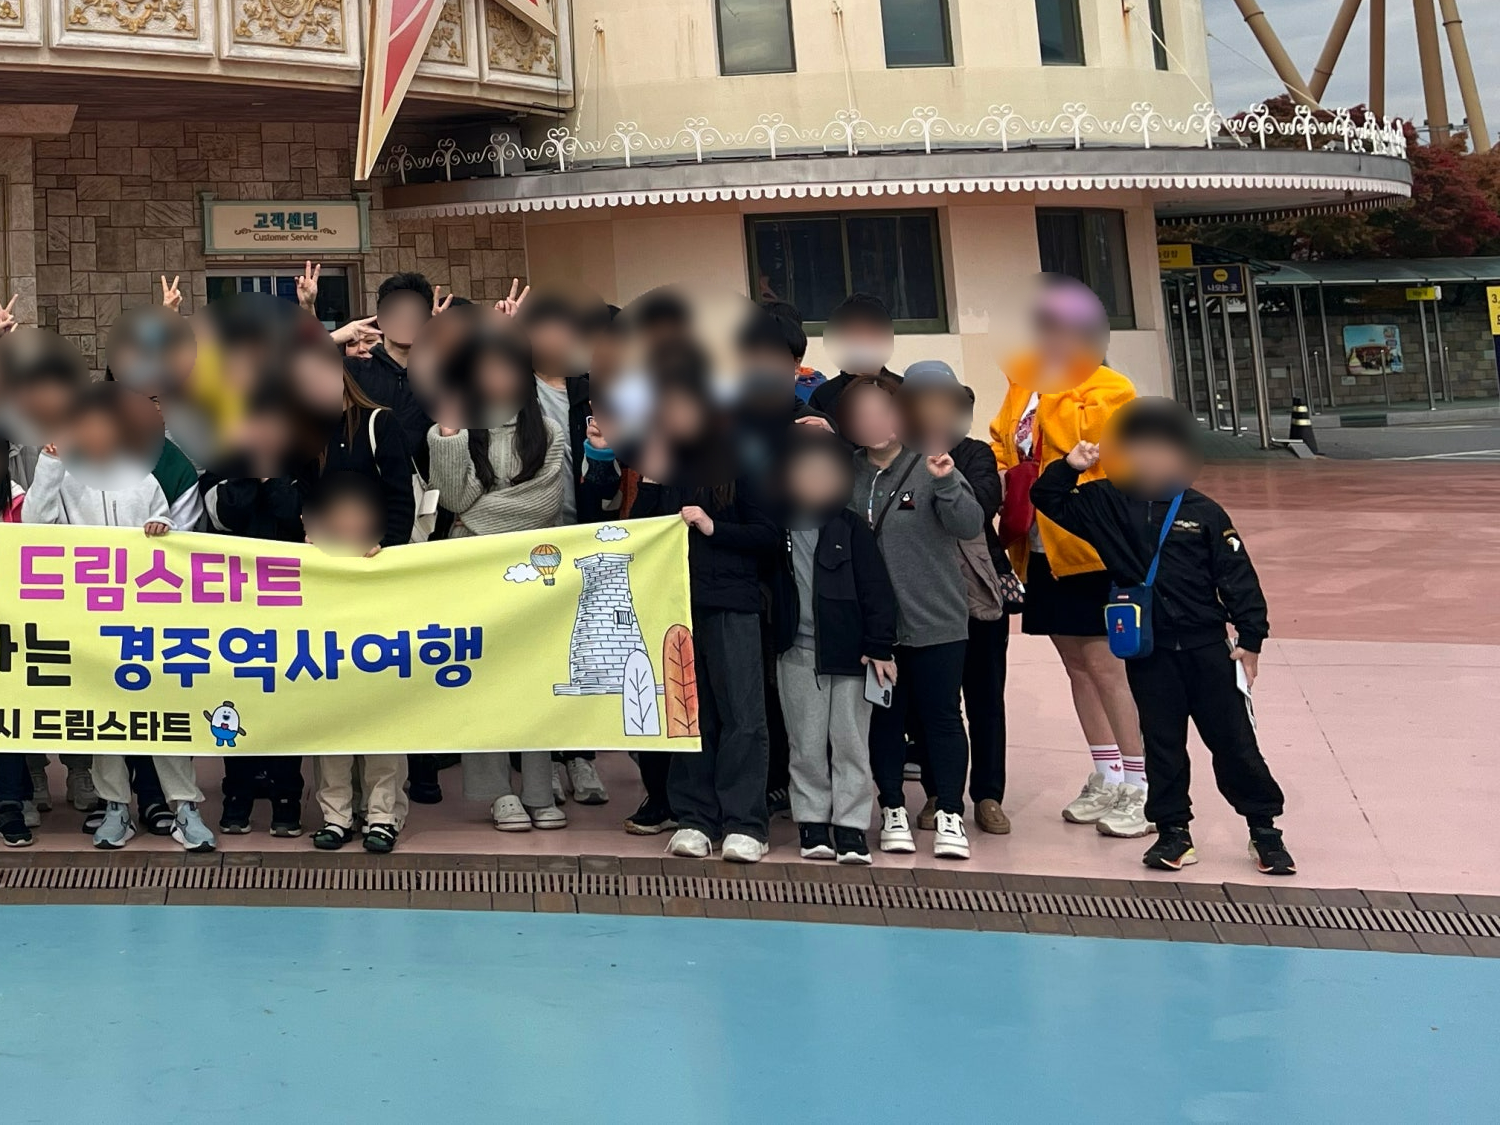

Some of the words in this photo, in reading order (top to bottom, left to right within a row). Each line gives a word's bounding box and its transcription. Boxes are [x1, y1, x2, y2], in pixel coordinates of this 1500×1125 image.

[253, 212, 318, 230] 고객센터
[253, 233, 289, 241] Customer
[290, 233, 318, 241] Service
[19, 546, 303, 611] 드림스타트
[100, 623, 483, 693] 경주역사여행
[32, 708, 192, 742] 드림스타트
